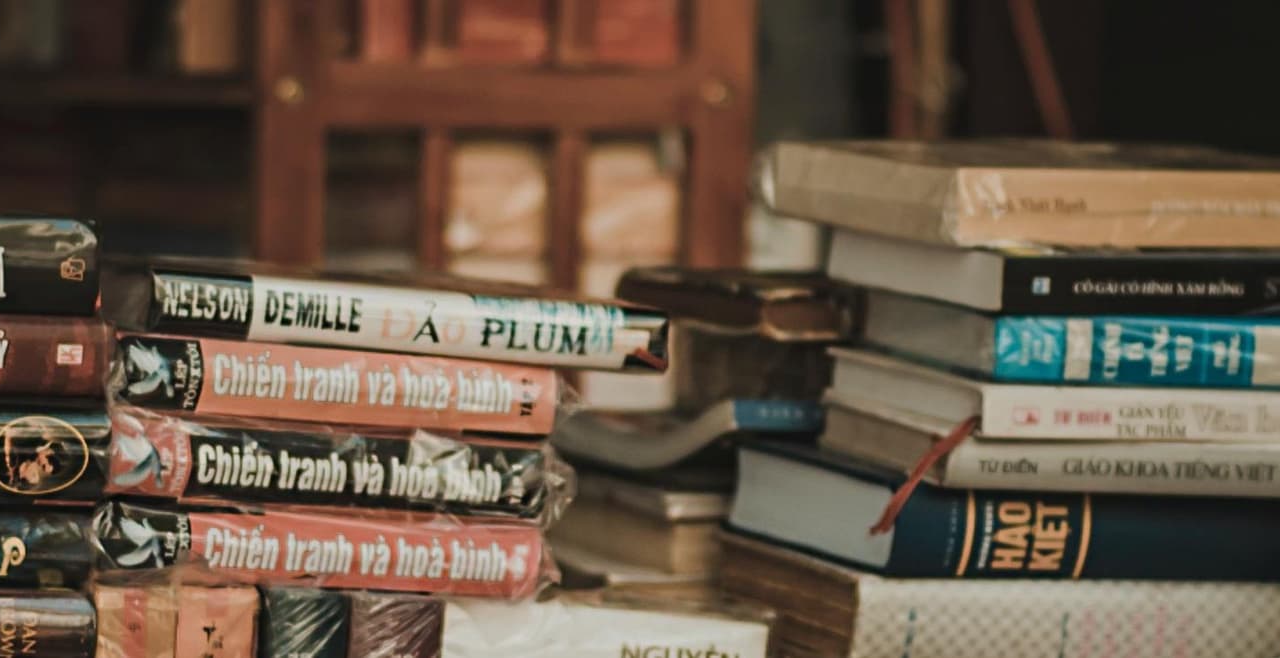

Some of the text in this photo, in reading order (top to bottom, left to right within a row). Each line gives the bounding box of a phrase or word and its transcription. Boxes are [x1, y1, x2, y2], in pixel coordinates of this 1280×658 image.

[160, 281, 251, 325] NELSON
[480, 317, 587, 356] PLUM
[213, 350, 287, 399] Chiến
[293, 358, 361, 404] tranh
[367, 363, 397, 406] và
[456, 367, 512, 414] bình
[197, 440, 275, 488] Chiến
[277, 449, 348, 493] tranh
[352, 452, 386, 496] và
[1114, 459, 1169, 478] KHOA
[204, 524, 280, 571] Chiến
[285, 531, 355, 576] tranh
[359, 534, 392, 577] và
[449, 538, 508, 583] bình
